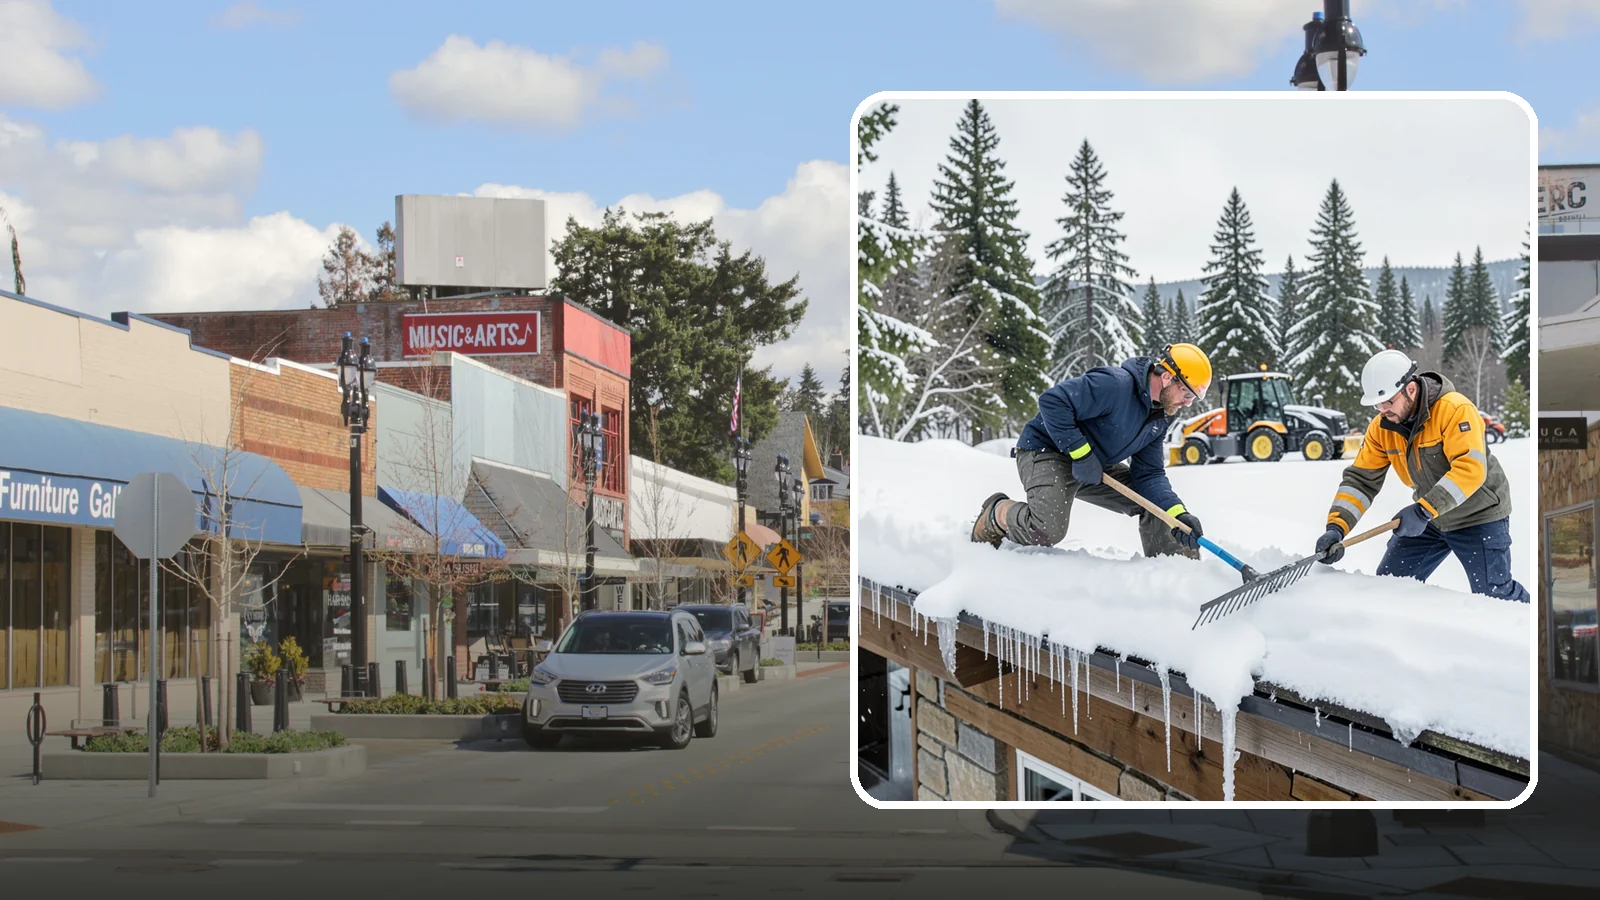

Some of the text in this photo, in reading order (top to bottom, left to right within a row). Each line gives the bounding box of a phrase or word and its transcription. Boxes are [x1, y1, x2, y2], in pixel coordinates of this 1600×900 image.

[409, 323, 520, 349] MUSIC&ARTS
[1540, 428, 1577, 436] UGA
[0, 471, 121, 519] Furniture Gal
[454, 563, 480, 574] SUSHI
